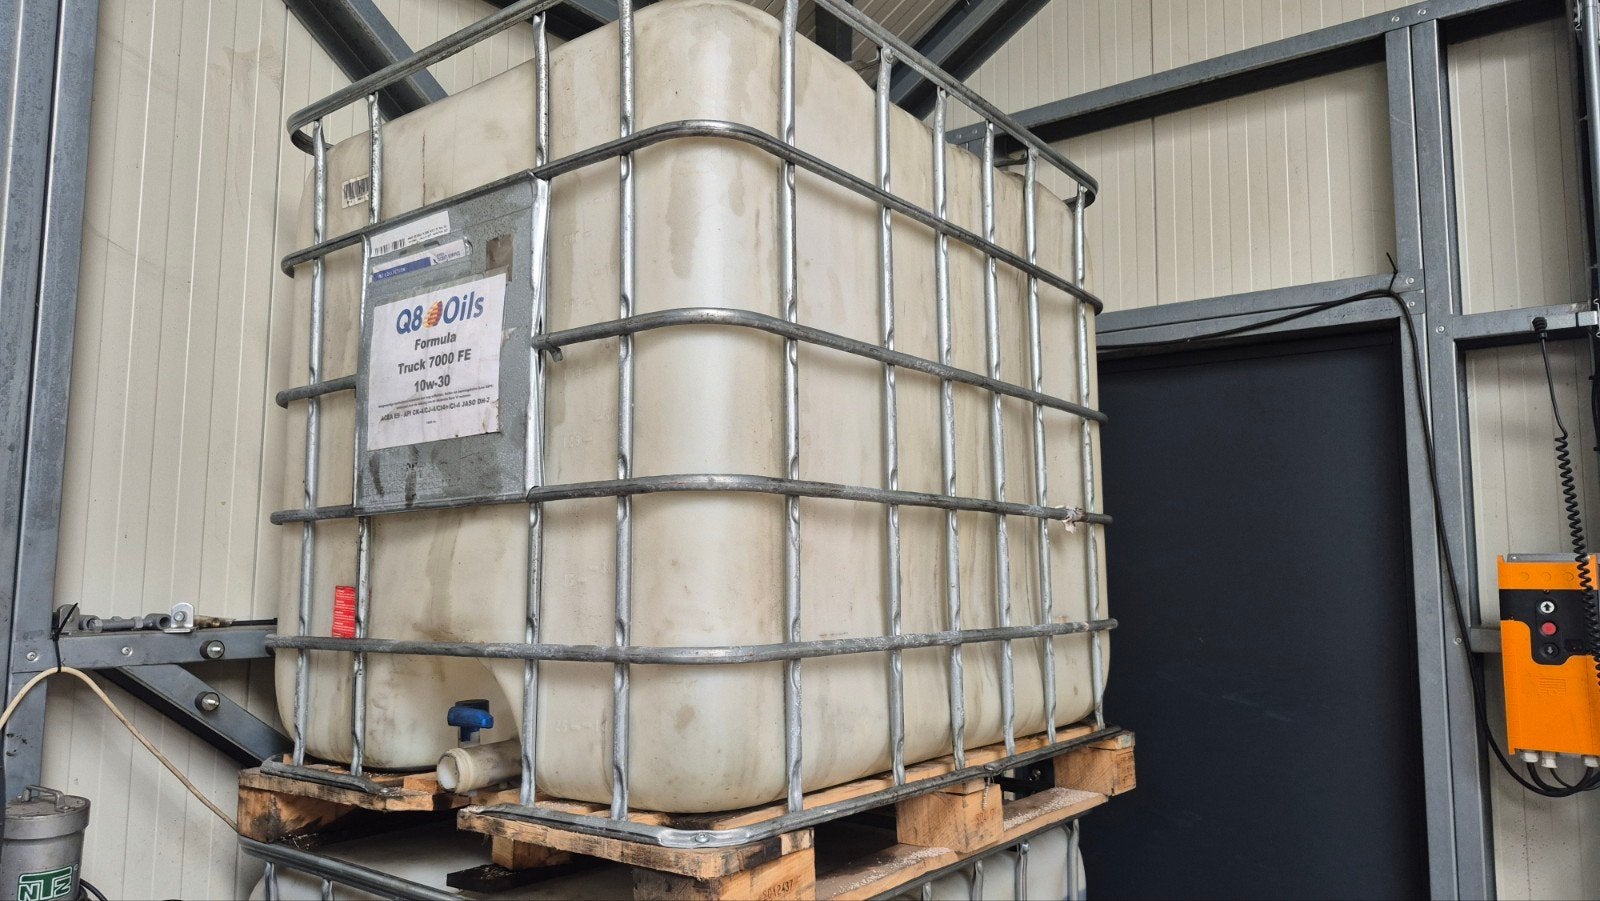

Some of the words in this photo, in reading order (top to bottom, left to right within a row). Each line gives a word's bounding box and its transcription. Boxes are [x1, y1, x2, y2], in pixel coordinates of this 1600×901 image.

[396, 305, 424, 335] Q8
[443, 291, 484, 324] Oils
[414, 332, 457, 351] Formula
[398, 360, 426, 375] Truck
[429, 352, 455, 369] 7000
[457, 348, 472, 363] FE
[414, 374, 451, 393] 10w-30
